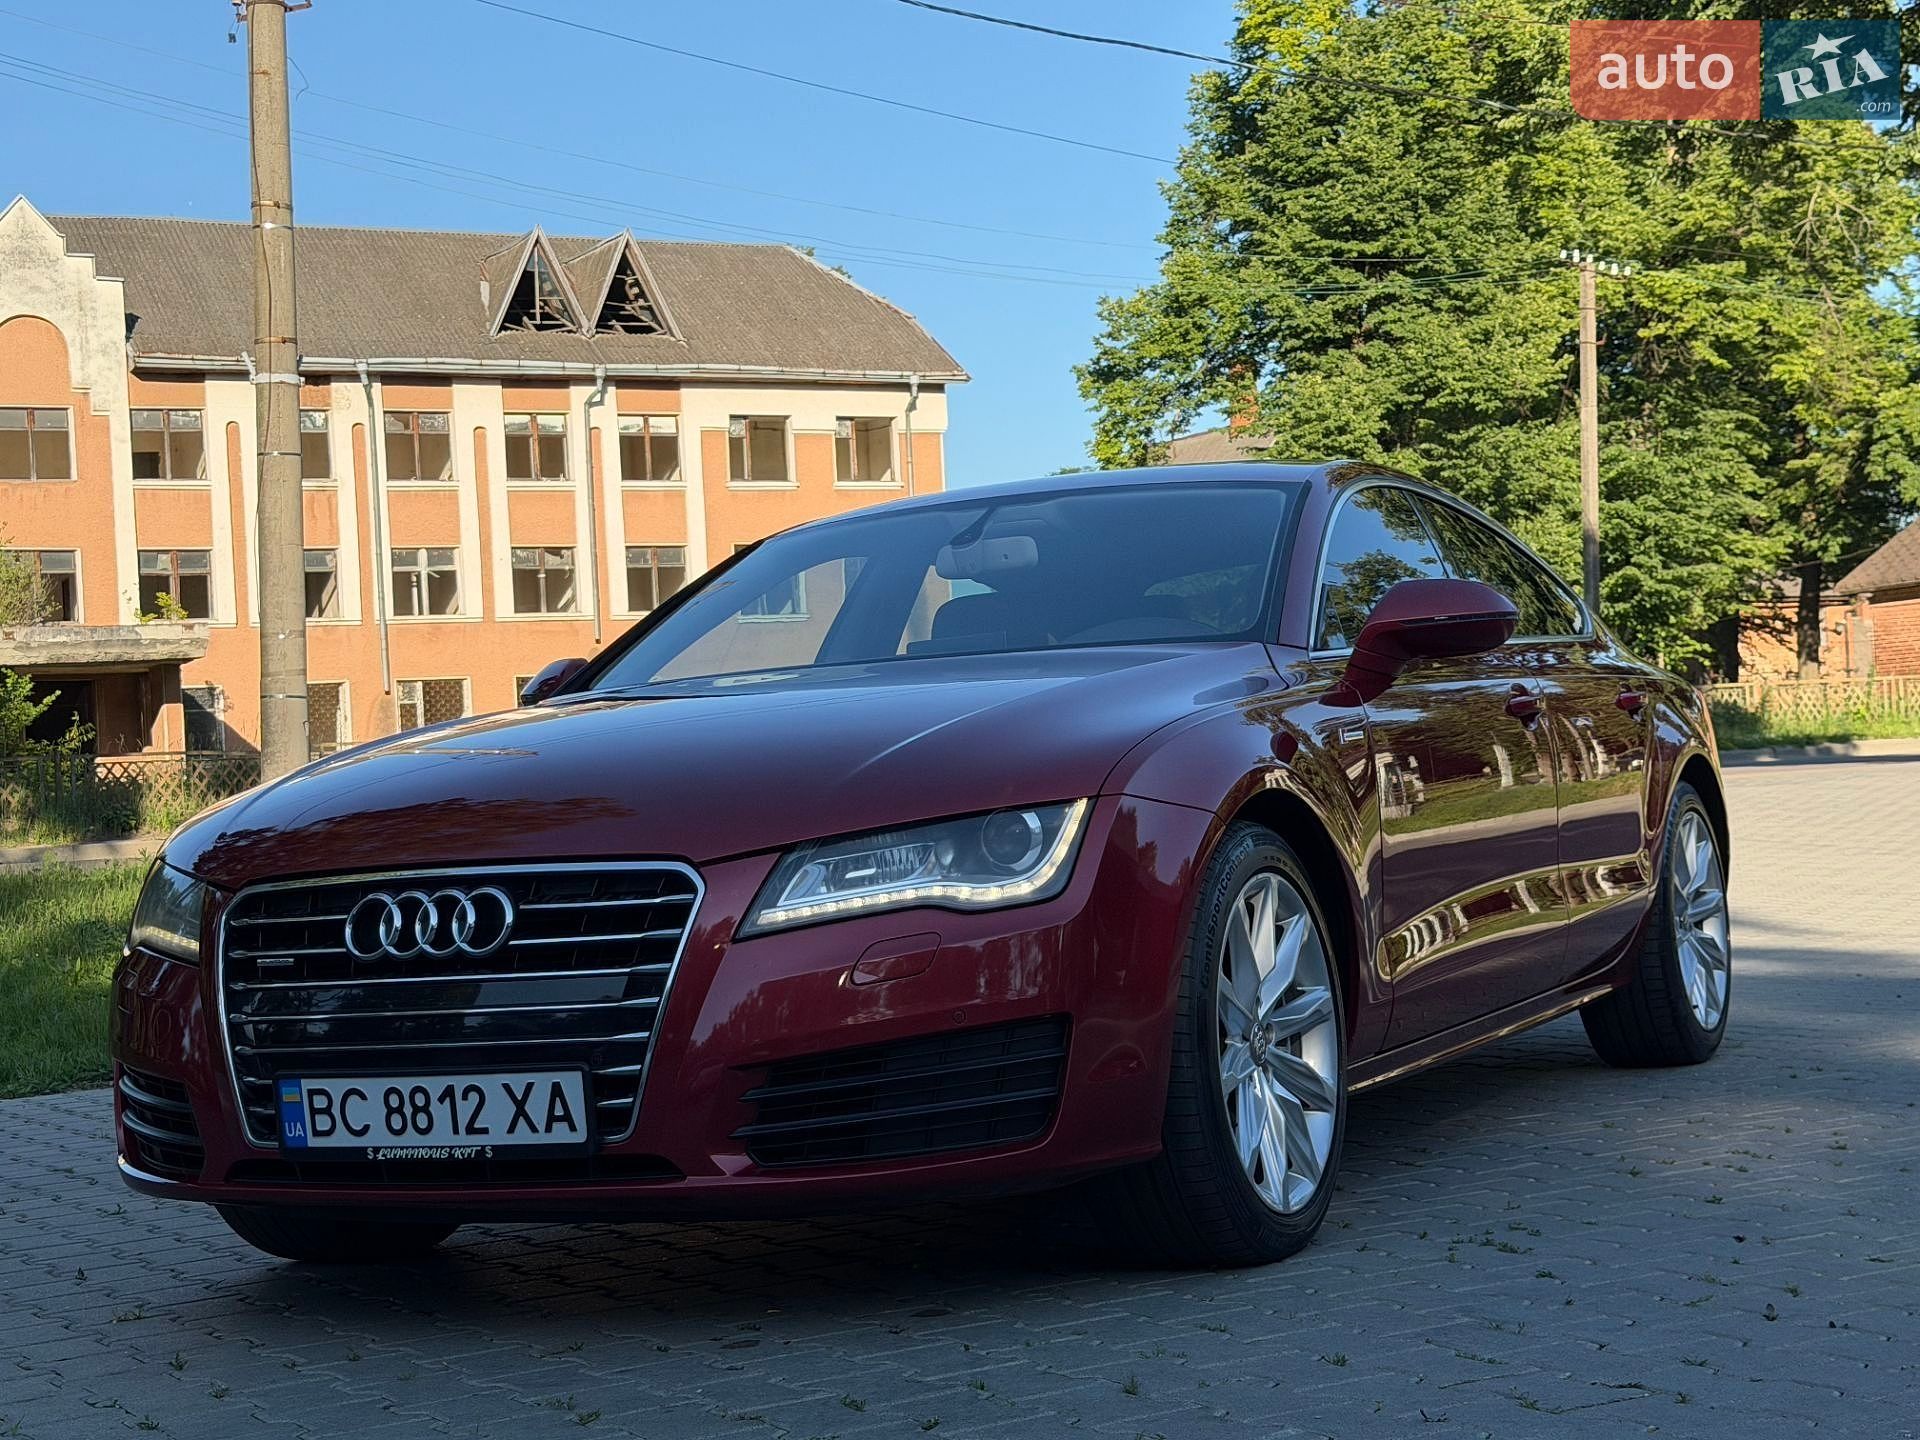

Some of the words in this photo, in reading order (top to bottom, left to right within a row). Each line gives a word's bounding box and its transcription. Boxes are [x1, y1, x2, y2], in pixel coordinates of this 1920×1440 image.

[306, 1086, 371, 1137] BC
[383, 1083, 490, 1136] 8812
[501, 1080, 578, 1134] XA
[285, 1121, 305, 1138] UA
